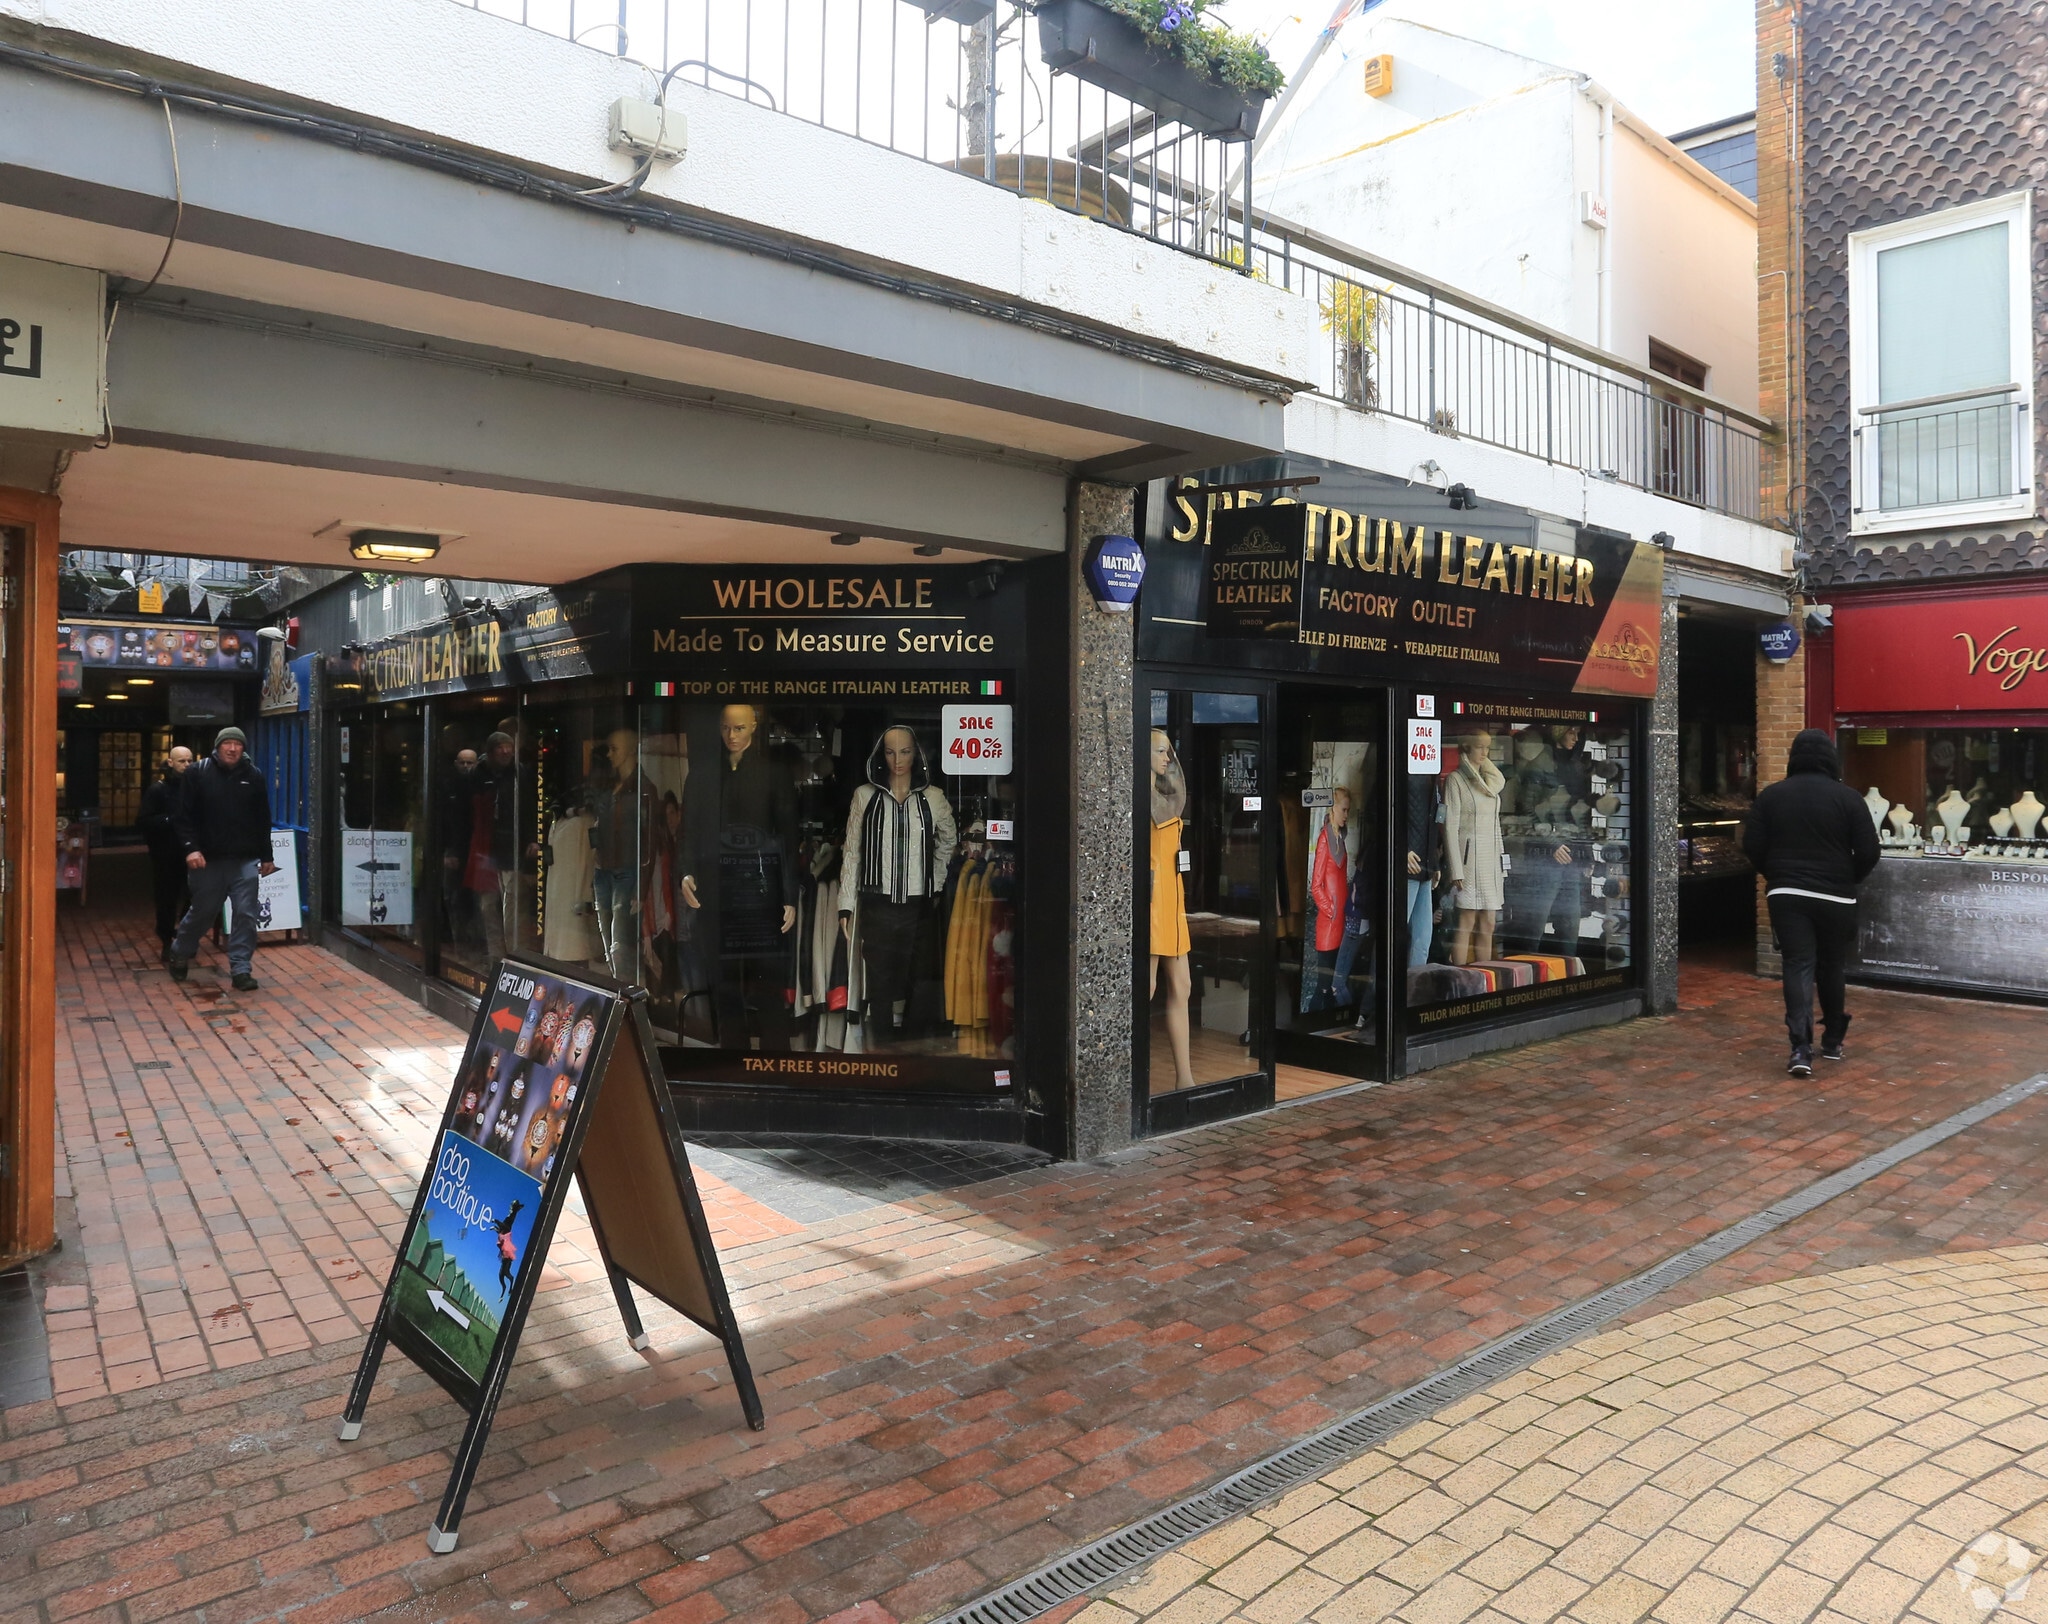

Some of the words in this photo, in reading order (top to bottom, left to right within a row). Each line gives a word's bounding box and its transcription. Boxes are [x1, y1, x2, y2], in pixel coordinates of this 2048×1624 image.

[1172, 476, 1425, 579] SPTRUM
[1438, 530, 1595, 608] LEATHER
[1114, 572, 1132, 580] Security
[1212, 560, 1299, 582] SPECTRUM
[712, 578, 933, 609] WHOLESALE
[1216, 584, 1293, 604] LEATHER
[526, 606, 559, 630] FACTORY
[562, 598, 594, 623] OUTLET
[1319, 587, 1399, 619] FACTORY
[1411, 599, 1477, 629] OUTLET
[1239, 618, 1265, 626] LONDON
[653, 628, 723, 652] Made
[733, 628, 765, 652] To
[776, 628, 887, 652] Measure
[897, 627, 995, 653] Service
[1291, 629, 1326, 646] ELLE
[1328, 633, 1341, 648] DI
[1343, 635, 1387, 652] FIRENZE
[1404, 640, 1460, 661] VERAPELLE
[1460, 647, 1501, 665] ITALIANA
[421, 620, 502, 684] LEATHER
[681, 681, 712, 695] TOP
[716, 681, 736, 695] OF
[740, 681, 769, 695] THE
[774, 681, 828, 695] RANGE
[832, 681, 896, 695] ITALIAN
[902, 681, 971, 695] LEATHER
[959, 716, 994, 730] SALE
[1468, 703, 1483, 714] TOP
[1485, 704, 1495, 715] OF
[1495, 705, 1509, 716] THE
[1510, 706, 1534, 718] RANGE
[1534, 708, 1560, 719] ITALIAN
[1561, 709, 1587, 721] LEATHER
[1415, 726, 1433, 738] SALE
[949, 737, 1002, 759] 40%
[982, 749, 1003, 759] OFF
[1410, 743, 1436, 761] 40%
[1426, 753, 1437, 761] OFF
[536, 850, 544, 936] ITALIANA
[1419, 1007, 1448, 1025] TAILOR
[1449, 1003, 1472, 1019] MADE
[1472, 997, 1503, 1013] LEATHER
[1505, 991, 1535, 1006] BESPOKE
[1535, 985, 1563, 1000] LEATHER
[1565, 983, 1578, 996] TAX
[1579, 980, 1592, 992] FREE
[1593, 974, 1623, 988] SHOPPING
[743, 1058, 775, 1072] TAX
[779, 1059, 814, 1074] FREE
[818, 1061, 899, 1077] SHOPPING
[441, 1143, 470, 1188] dog
[433, 1167, 493, 1232] boutique
